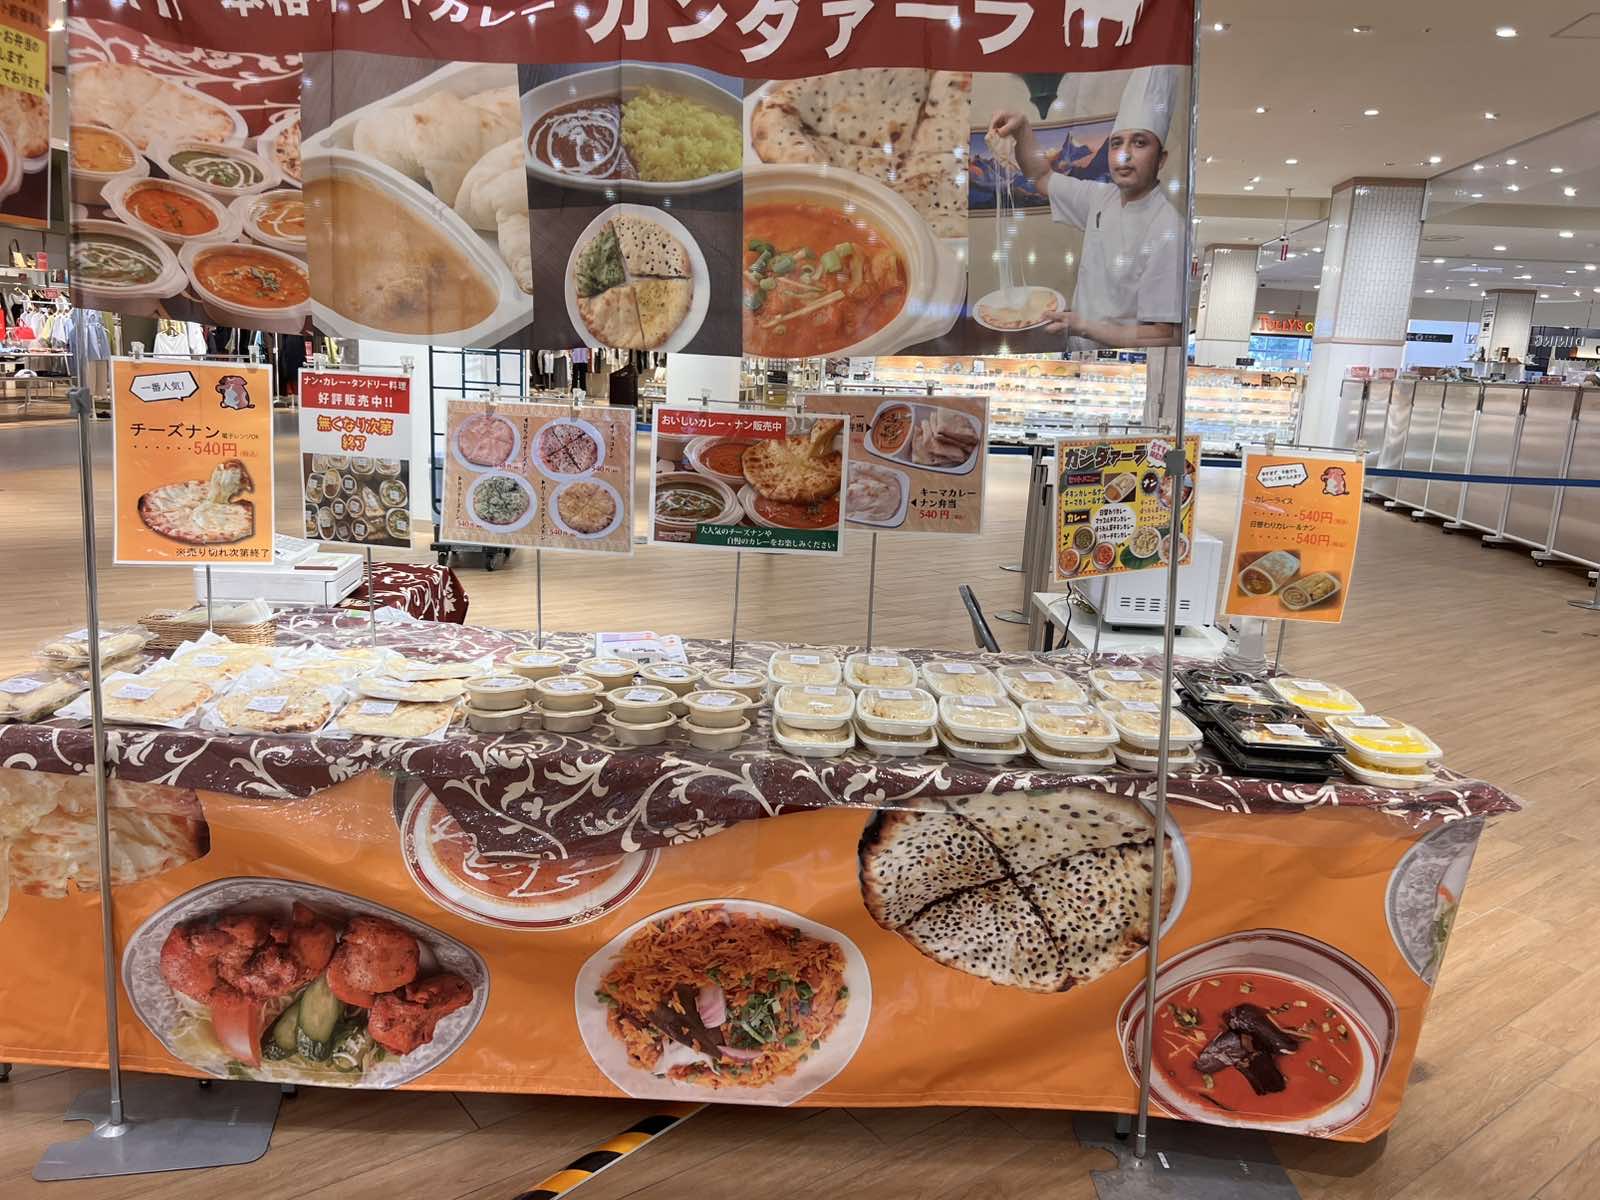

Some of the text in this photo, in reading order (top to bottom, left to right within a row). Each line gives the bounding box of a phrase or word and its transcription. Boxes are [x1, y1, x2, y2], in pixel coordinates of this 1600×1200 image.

[303, 376, 408, 391] ナン・カレー・タンドリー料理
[318, 392, 393, 408] 好評販売中!!
[130, 423, 220, 439] チーズナン
[317, 415, 394, 436] 無くなり次第
[661, 415, 782, 432] おいしいカレー・ナン販売中
[194, 442, 238, 457] 540円
[341, 434, 367, 451] 終了
[1065, 445, 1148, 470] ガンダァーラ
[920, 488, 976, 497] キーマカレー
[1254, 495, 1293, 504] カレーライス
[920, 499, 956, 509] ナン弁当
[1067, 513, 1088, 523] カレー
[700, 526, 773, 538] 大人気のチーズナンや
[1296, 533, 1330, 547] 540円
